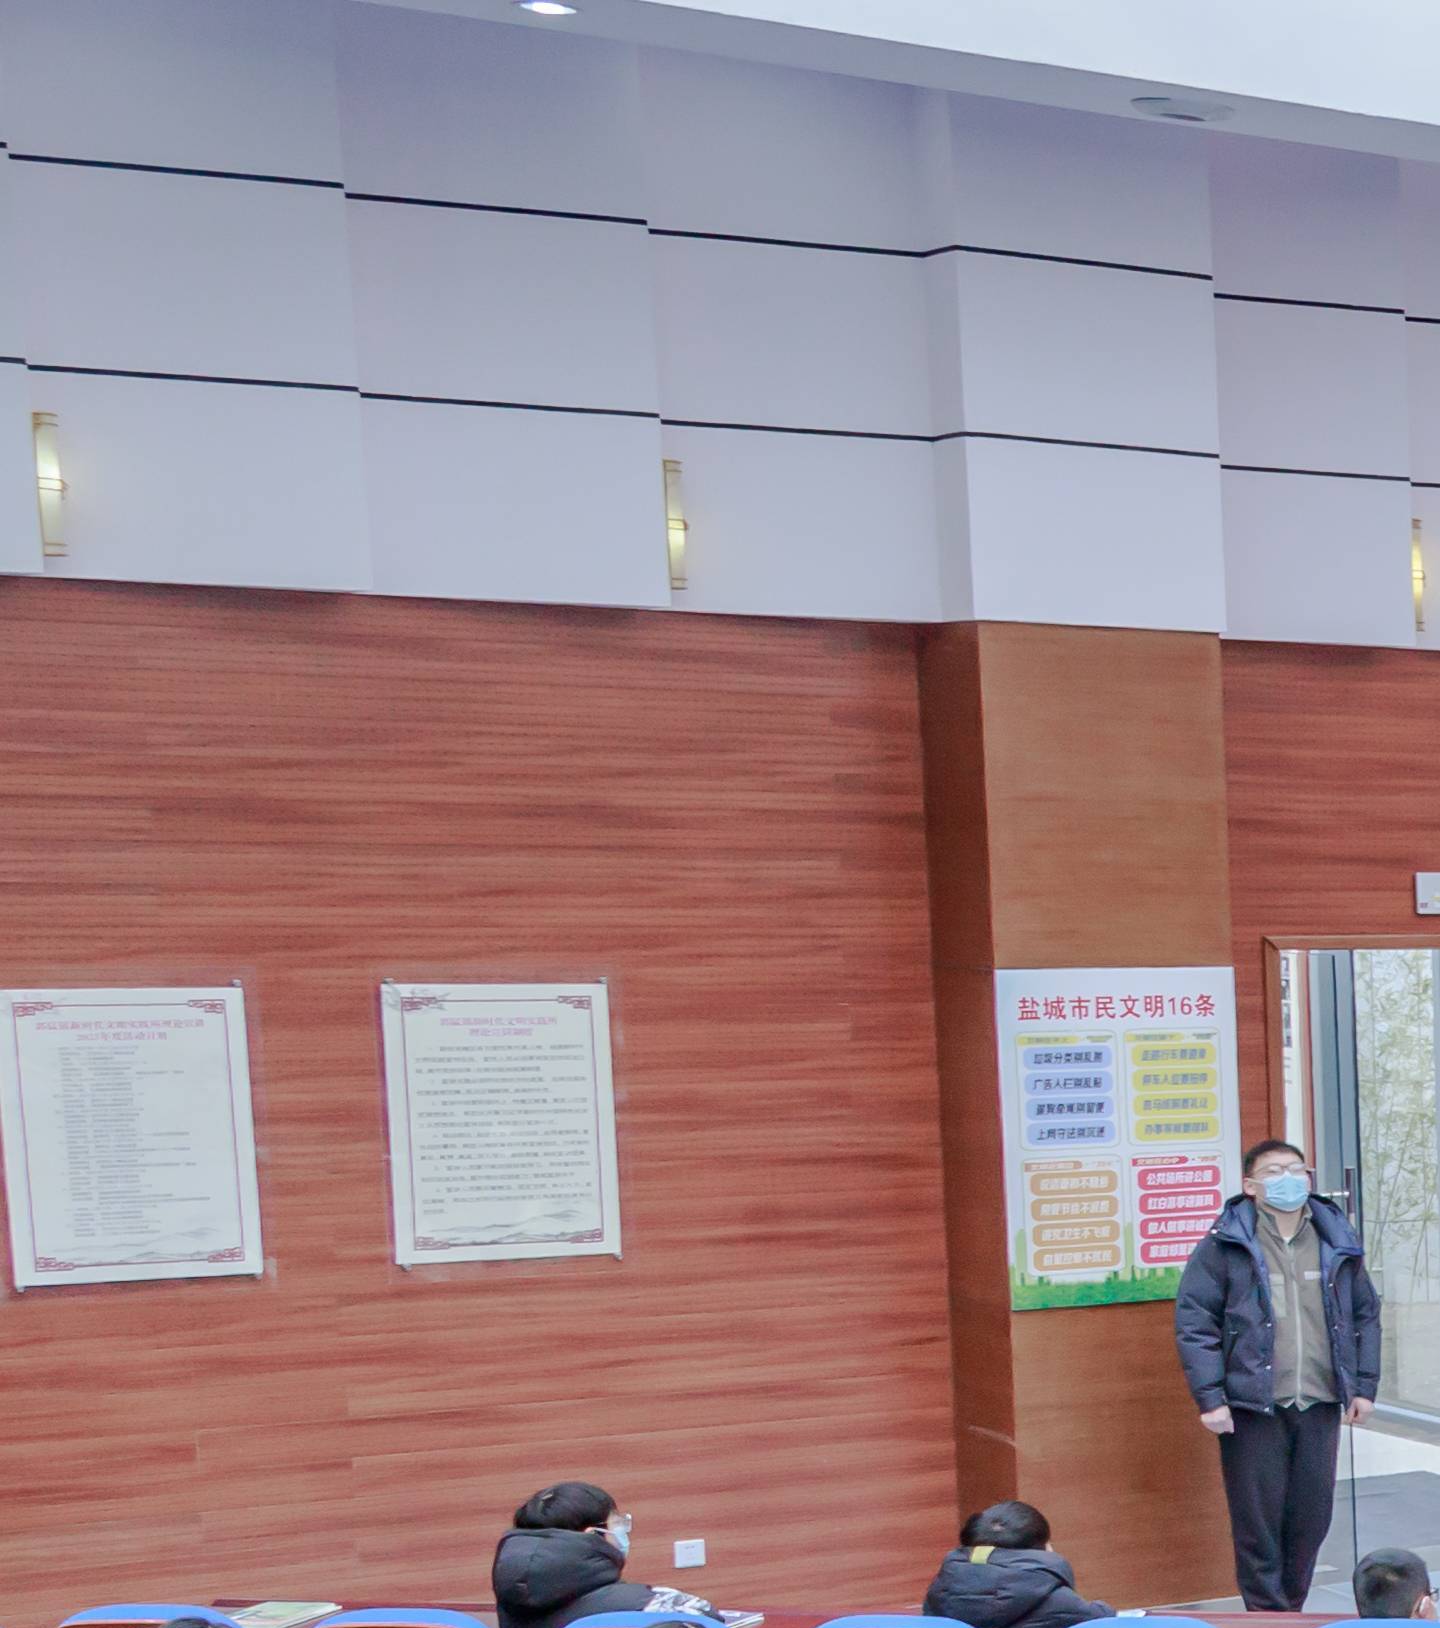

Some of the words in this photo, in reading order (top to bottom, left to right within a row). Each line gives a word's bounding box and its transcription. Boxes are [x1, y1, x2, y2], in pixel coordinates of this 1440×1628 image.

[1018, 995, 1216, 1021] 盐城市民文明16条
